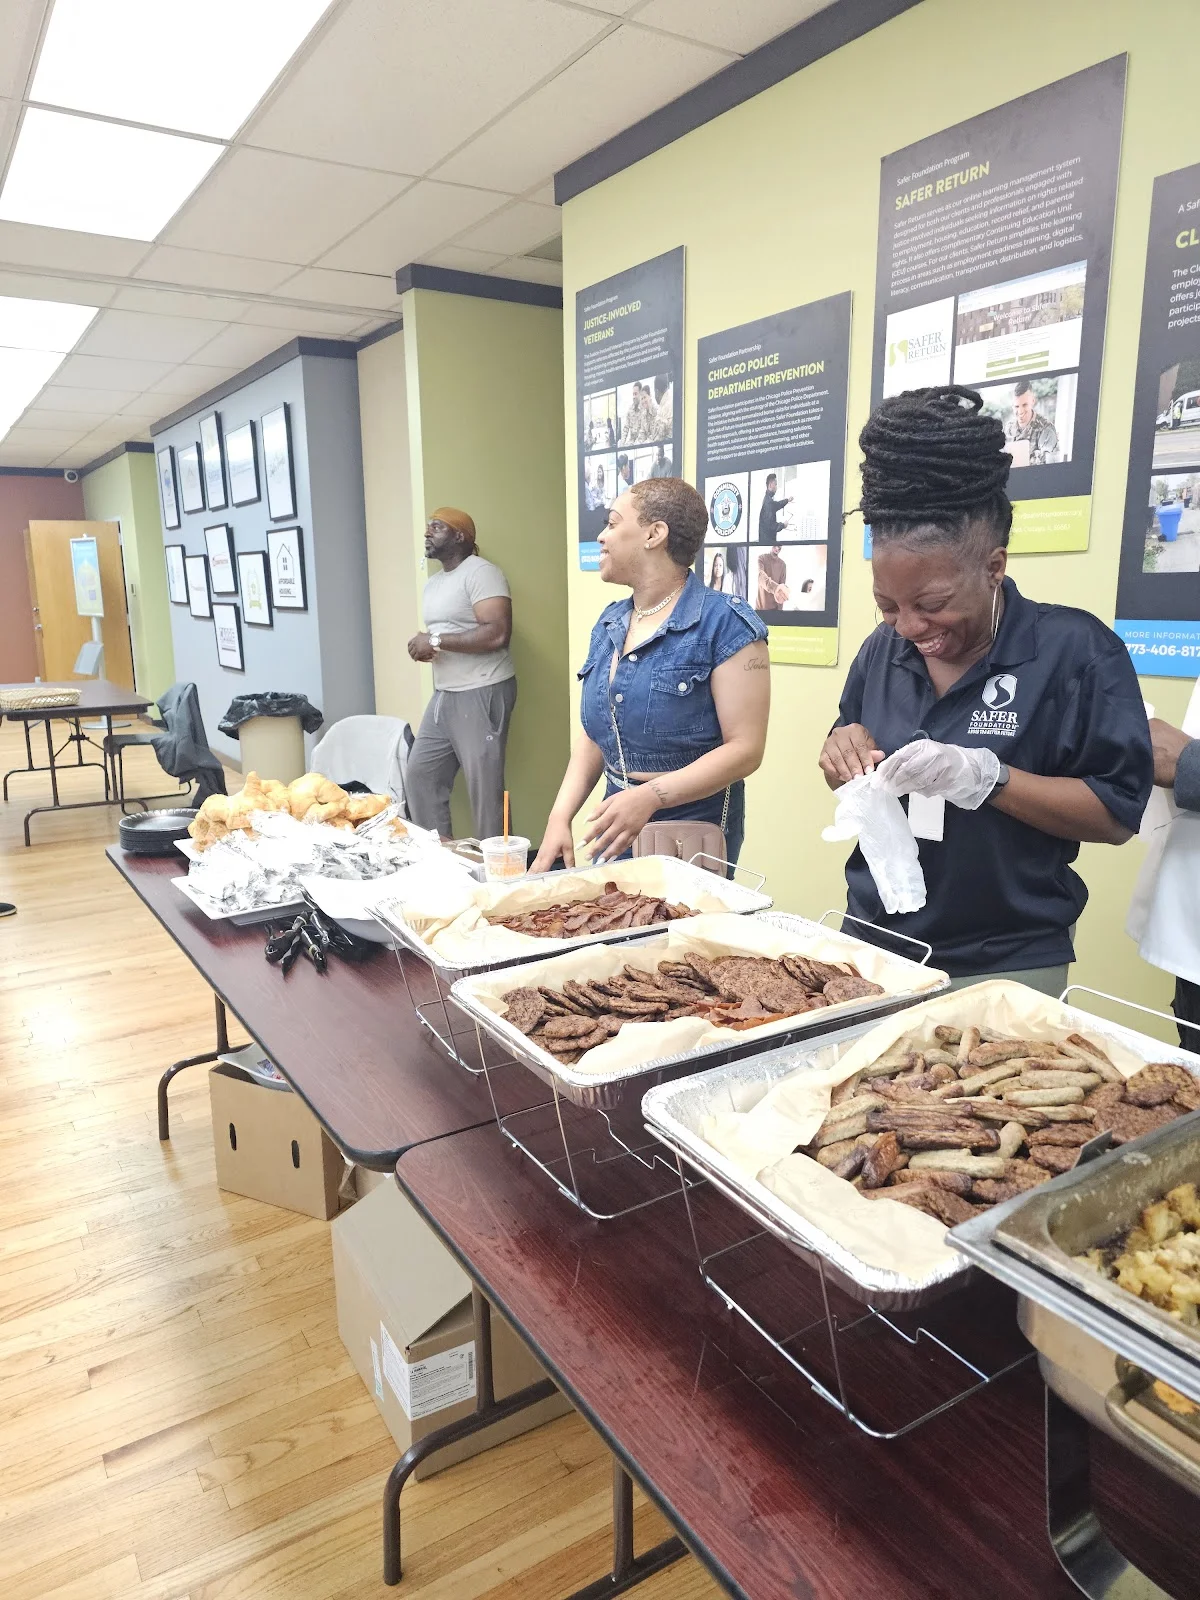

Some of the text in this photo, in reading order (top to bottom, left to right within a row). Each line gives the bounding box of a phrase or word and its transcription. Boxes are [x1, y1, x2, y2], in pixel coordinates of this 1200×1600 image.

[897, 152, 969, 187] Safer Foundation Program
[894, 219, 907, 228] Safer
[907, 212, 926, 223] Return
[926, 206, 944, 217] serves
[952, 200, 961, 208] our
[962, 192, 981, 204] online
[982, 183, 1008, 197] learning
[1009, 165, 1053, 187] management
[1055, 157, 1080, 172] system
[895, 161, 989, 210] SAFER RETURN
[893, 222, 917, 237] designed
[926, 215, 939, 226] both
[940, 213, 949, 221] our
[950, 206, 969, 217] clients
[971, 199, 982, 210] and
[983, 186, 1024, 208] professionals
[1025, 174, 1054, 191] engaged
[1056, 168, 1071, 181] with
[964, 210, 988, 223] seeking
[989, 197, 1025, 214] information
[1037, 186, 1056, 198] rights
[1058, 175, 1083, 191] related
[991, 210, 1011, 224] record
[1031, 199, 1044, 211] and
[1045, 189, 1074, 208] parental
[1178, 204, 1184, 214] A
[913, 252, 924, 260] also
[924, 247, 940, 257] offers
[941, 232, 984, 251] complimentary
[986, 220, 1020, 237] Continuing
[1022, 209, 1055, 225] Education
[1057, 202, 1072, 213] Unit
[928, 257, 937, 265] For
[938, 254, 947, 262] our
[969, 242, 984, 252] Safer
[986, 235, 1007, 246] Return
[1008, 225, 1039, 239] simplifies
[1040, 220, 1051, 229] the
[1053, 211, 1082, 225] learning
[1176, 228, 1199, 248] CL
[917, 269, 931, 278] areas
[932, 262, 945, 273] such
[953, 248, 991, 267] employment
[992, 240, 1022, 255] readiness
[1052, 221, 1074, 236] digital
[1039, 239, 1052, 251] and
[1172, 268, 1188, 278] The
[1170, 291, 1193, 303] offers
[584, 300, 641, 330] JUSTICE-INVOLVED
[1032, 303, 1048, 312] Safer
[584, 327, 614, 345] VETERANS
[908, 332, 942, 350] SAFER
[739, 344, 761, 355] Partnership
[908, 343, 947, 360] RETURN
[708, 353, 779, 382] CHICAGO POLICE
[708, 361, 824, 400] DEPARTMENT PREVENTION
[713, 482, 740, 499] COMMUNITY
[1124, 631, 1200, 640] MORE INFORMAT
[1125, 643, 1200, 657] 773-406-817
[971, 710, 1017, 724] SAFER
